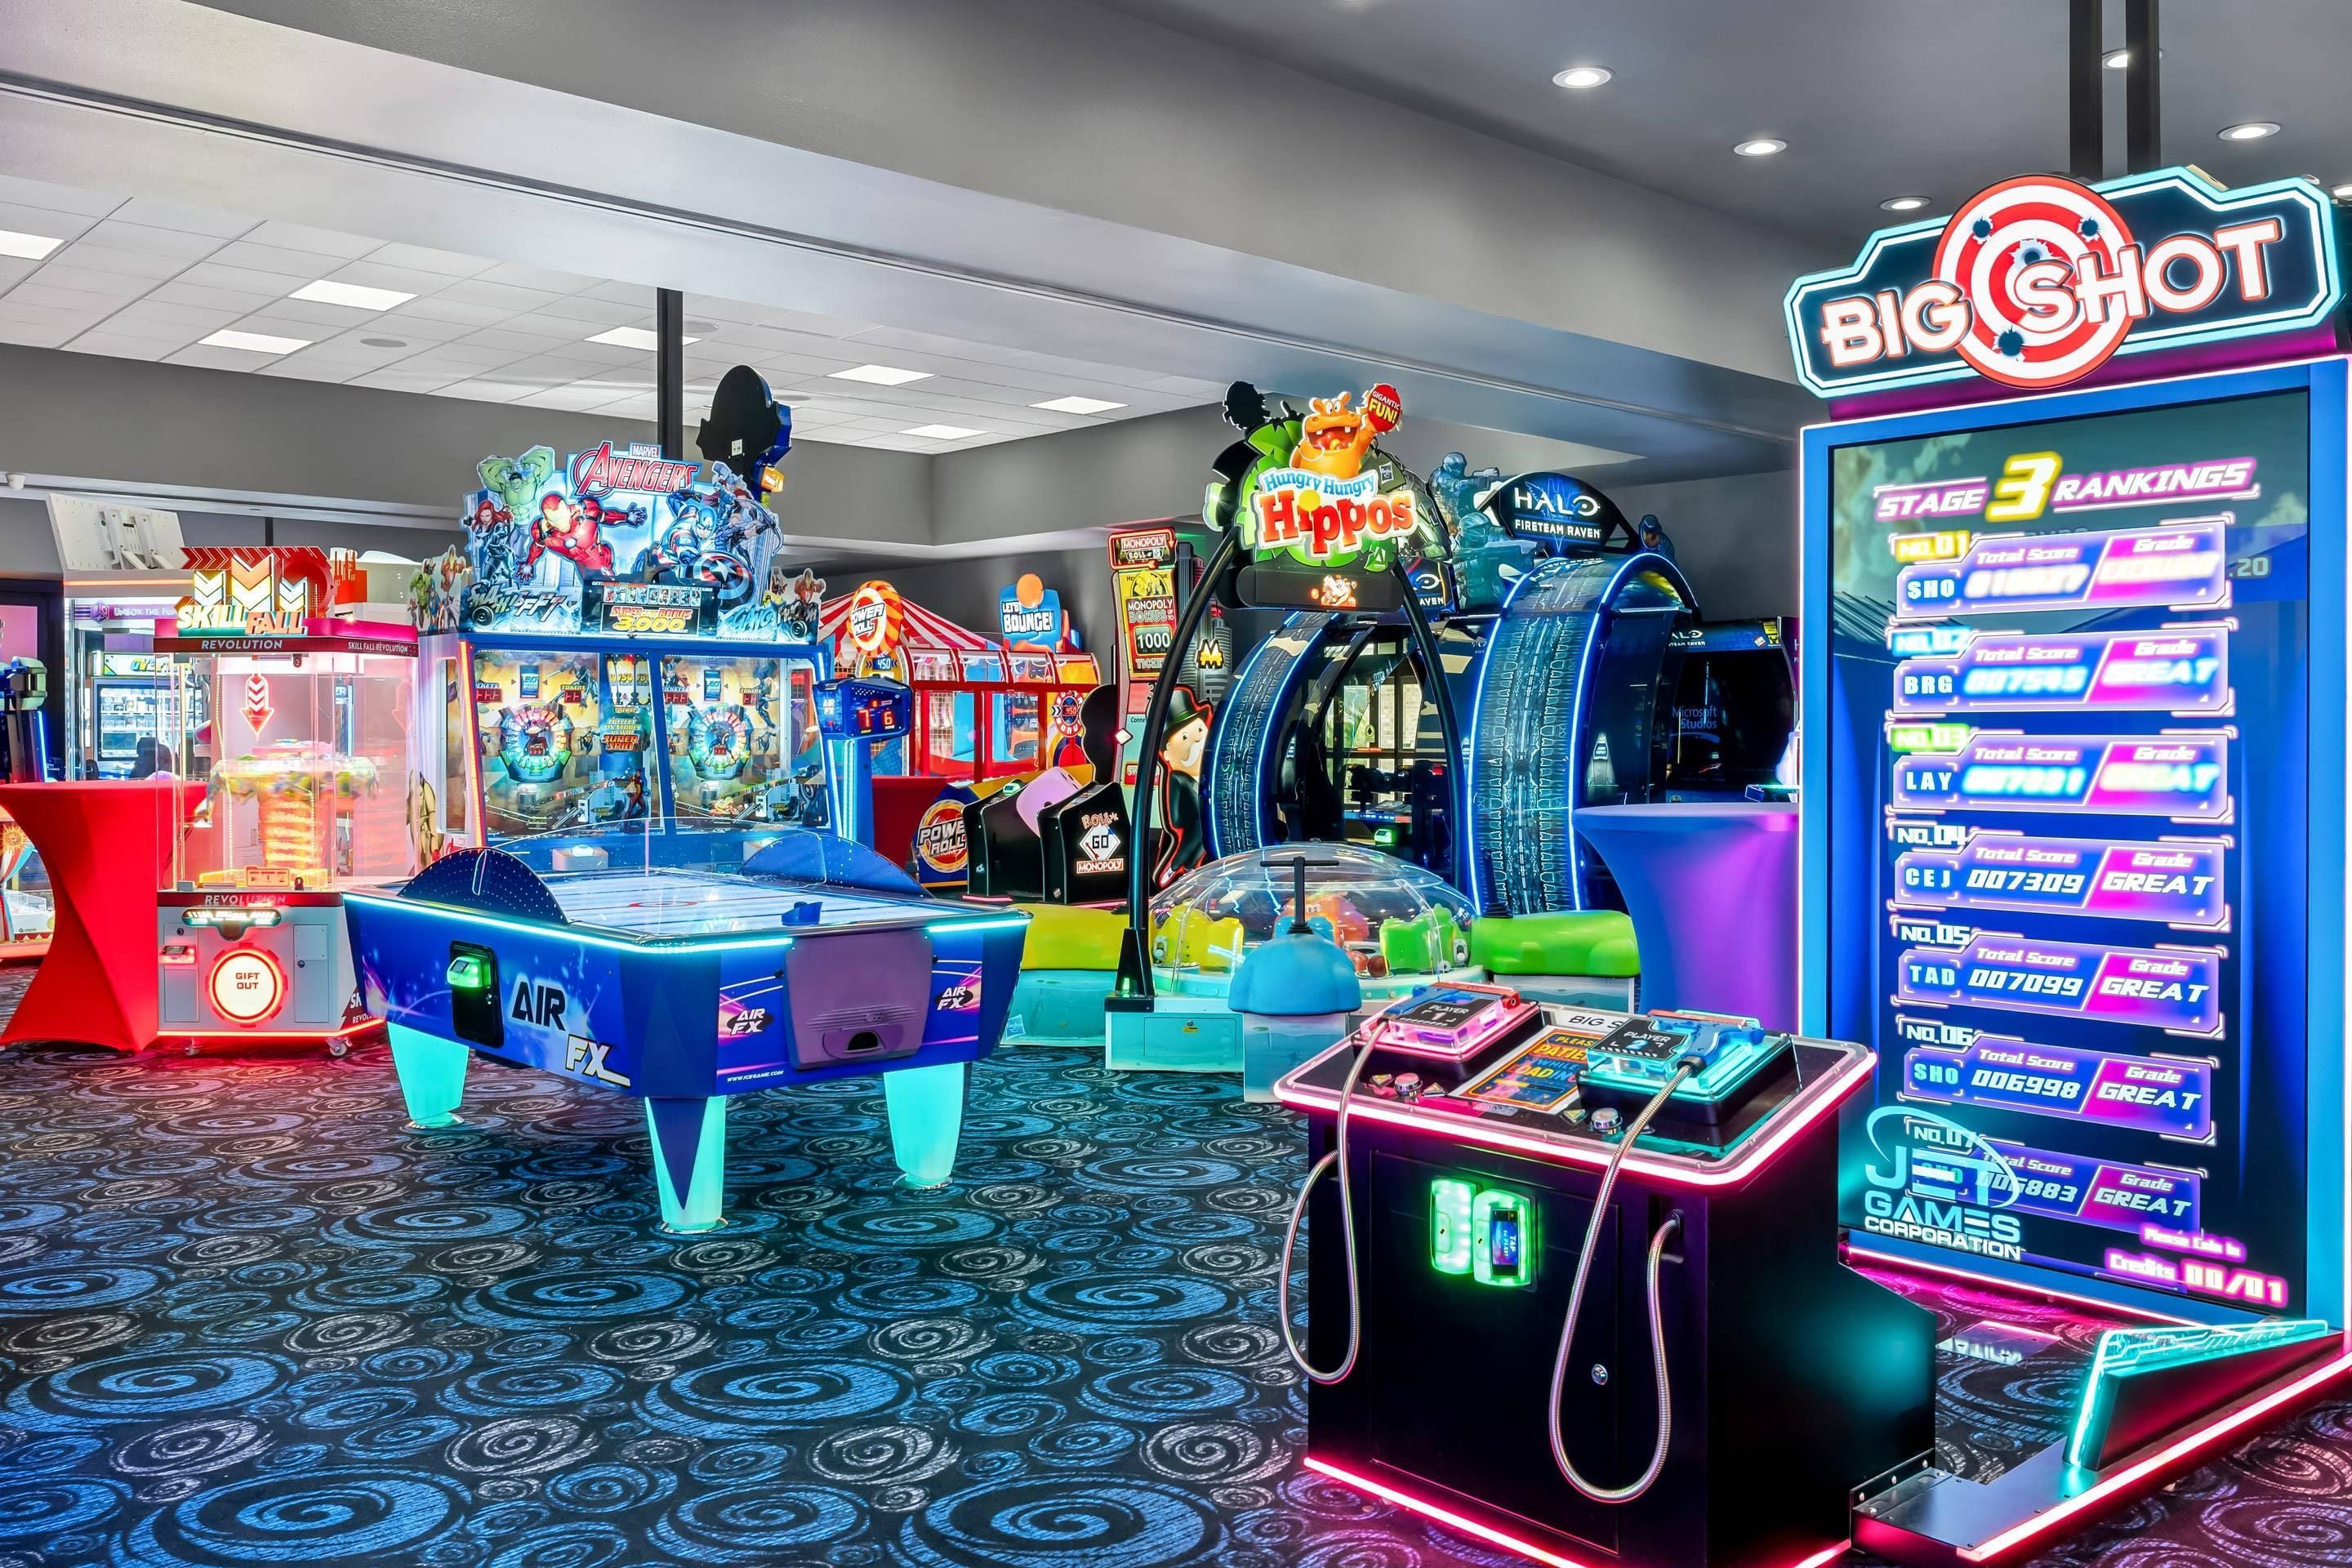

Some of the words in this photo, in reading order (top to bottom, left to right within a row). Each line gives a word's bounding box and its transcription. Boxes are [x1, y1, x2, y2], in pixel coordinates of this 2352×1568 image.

[1823, 281, 1971, 367] BIG
[2014, 218, 2282, 334] SHOT
[1372, 390, 1401, 410] GIGANTIC
[1369, 399, 1397, 423] FUN!
[632, 445, 658, 458] MARVEL
[577, 442, 698, 495] AVENGERS
[1265, 472, 1321, 492] Hungry
[1323, 474, 1374, 497] Hungry
[1878, 488, 1986, 518] STAGE
[1988, 453, 2060, 520] 3
[2053, 461, 2252, 501] RANKINGS
[1514, 488, 1601, 516] HALO
[1515, 519, 1564, 534] FIRETEAM
[1567, 526, 1601, 539] RAVEN
[1124, 536, 1164, 549] MONOPOLY
[1976, 548, 2024, 564] Total
[2027, 548, 2078, 561] Score
[2133, 535, 2194, 552] Grade
[1908, 579, 1955, 599] SHO
[1128, 599, 1173, 611] MONOPOLY
[1420, 597, 1444, 606] AVEN
[177, 605, 245, 629] SKILL
[246, 612, 304, 635] FALL
[1004, 612, 1053, 633] BOUNCE!
[202, 640, 283, 649] REVOLUTION
[348, 642, 363, 650] SKILL
[363, 643, 375, 651] FALL
[376, 644, 408, 653] REVOLUTION
[1137, 632, 1170, 648] 1000
[1976, 647, 2024, 662] Total
[2025, 648, 2078, 660] Score
[2134, 639, 2197, 657] Grade
[877, 658, 891, 670] 450
[1904, 675, 1952, 694] BRG
[2101, 659, 2217, 686] GREAT
[823, 699, 834, 707] AIR
[1673, 706, 1717, 717] Microsoft
[858, 710, 871, 728] 7
[884, 710, 893, 725] 6
[1681, 718, 1717, 729] Studios
[1975, 747, 2024, 760] Total
[2026, 748, 2078, 760] Score
[2134, 747, 2195, 761] Grade
[1906, 772, 1952, 791] LAY
[1081, 813, 1112, 829] ROLL
[919, 818, 965, 845] POWE
[1898, 825, 1967, 845] NO.04
[1092, 835, 1109, 849] GO
[1079, 861, 1122, 872] MONOPOLY
[1976, 847, 2021, 862] Total
[2026, 850, 2076, 863] Score
[2132, 853, 2193, 867] Grade
[1905, 868, 1950, 888] CEJ
[1967, 870, 2085, 893] 007309
[2101, 873, 2215, 896] GREAT
[205, 894, 286, 905] REVOLUTION
[1901, 924, 1971, 944] NO.05
[1977, 948, 2023, 963] Total
[2027, 952, 2075, 966] Score
[2130, 960, 2189, 975] Grade
[942, 987, 966, 997] AIR
[1909, 965, 1955, 985] TAD
[1968, 969, 2083, 996] 007099
[2100, 976, 2209, 1003] GREAT
[512, 981, 566, 1031] AIR
[937, 997, 964, 1010] FX
[1429, 1004, 1469, 1014] PLAYER
[737, 1008, 765, 1021] AIR
[1569, 1015, 1603, 1027] BIG
[731, 1020, 762, 1036] FX
[1624, 1031, 1671, 1043] PLAYER
[1906, 1026, 1973, 1046] NO.06
[1554, 1036, 1594, 1047] PLEAS
[1625, 1039, 1648, 1050] 2
[565, 1034, 630, 1088] FX
[1533, 1044, 1587, 1061] PATIE
[1537, 1059, 1579, 1071] WHILE
[1980, 1049, 2025, 1066] Total
[2028, 1055, 2074, 1071] Score
[2126, 1067, 2181, 1084] Grade
[1914, 1062, 1958, 1085] SHO
[1971, 1069, 2081, 1099] 006998
[2097, 1082, 2201, 1111] GREAT
[1865, 1145, 2006, 1207] JET
[2028, 1159, 2072, 1176] Score
[2121, 1174, 2173, 1192] Grade
[2093, 1187, 2192, 1217] GREAT
[1865, 1191, 2020, 1243] GAMES
[1864, 1216, 2021, 1261] CORPORATION
[2110, 1254, 2176, 1281] Credits
[2186, 1264, 2283, 1303] 00/01
